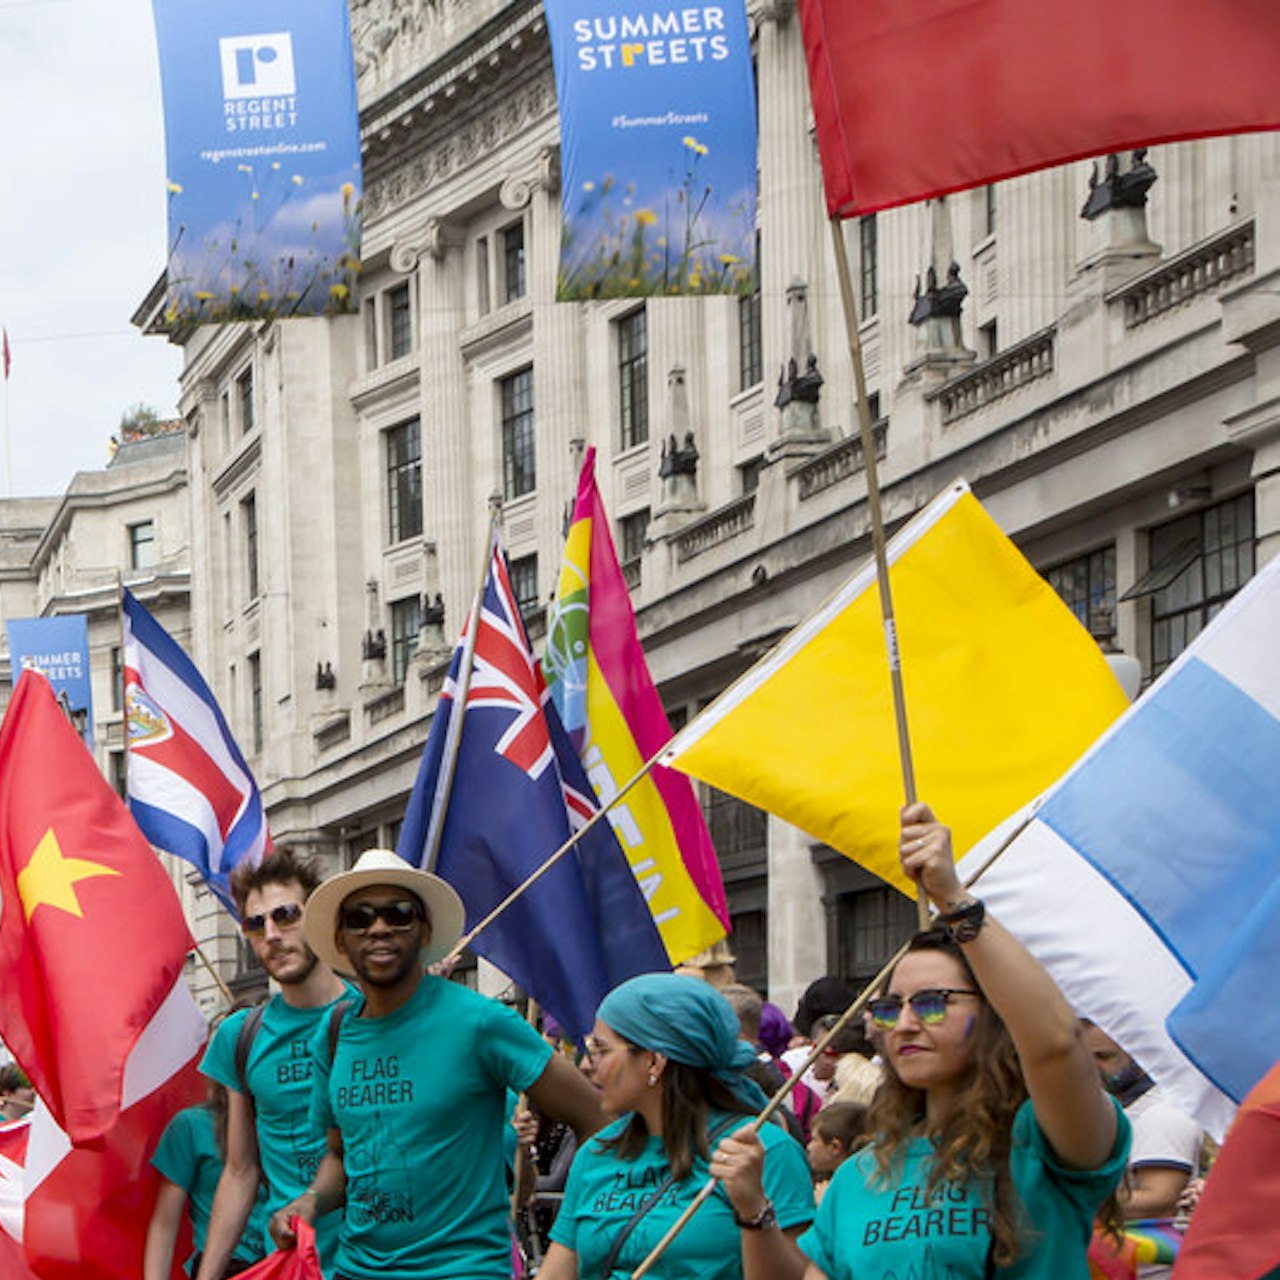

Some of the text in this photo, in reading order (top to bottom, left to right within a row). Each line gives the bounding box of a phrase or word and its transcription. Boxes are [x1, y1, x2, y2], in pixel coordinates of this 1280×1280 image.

[574, 7, 725, 43] SUMMER
[223, 97, 297, 116] REGENT
[225, 112, 298, 132] STREET
[611, 111, 709, 129] #SummerStreets
[291, 1040, 313, 1058] FL
[276, 1062, 315, 1085] BEA
[351, 1056, 400, 1082] FLAG
[337, 1079, 414, 1109] BEARER
[593, 1185, 678, 1213] BEAR
[862, 1207, 993, 1247] BEARER
